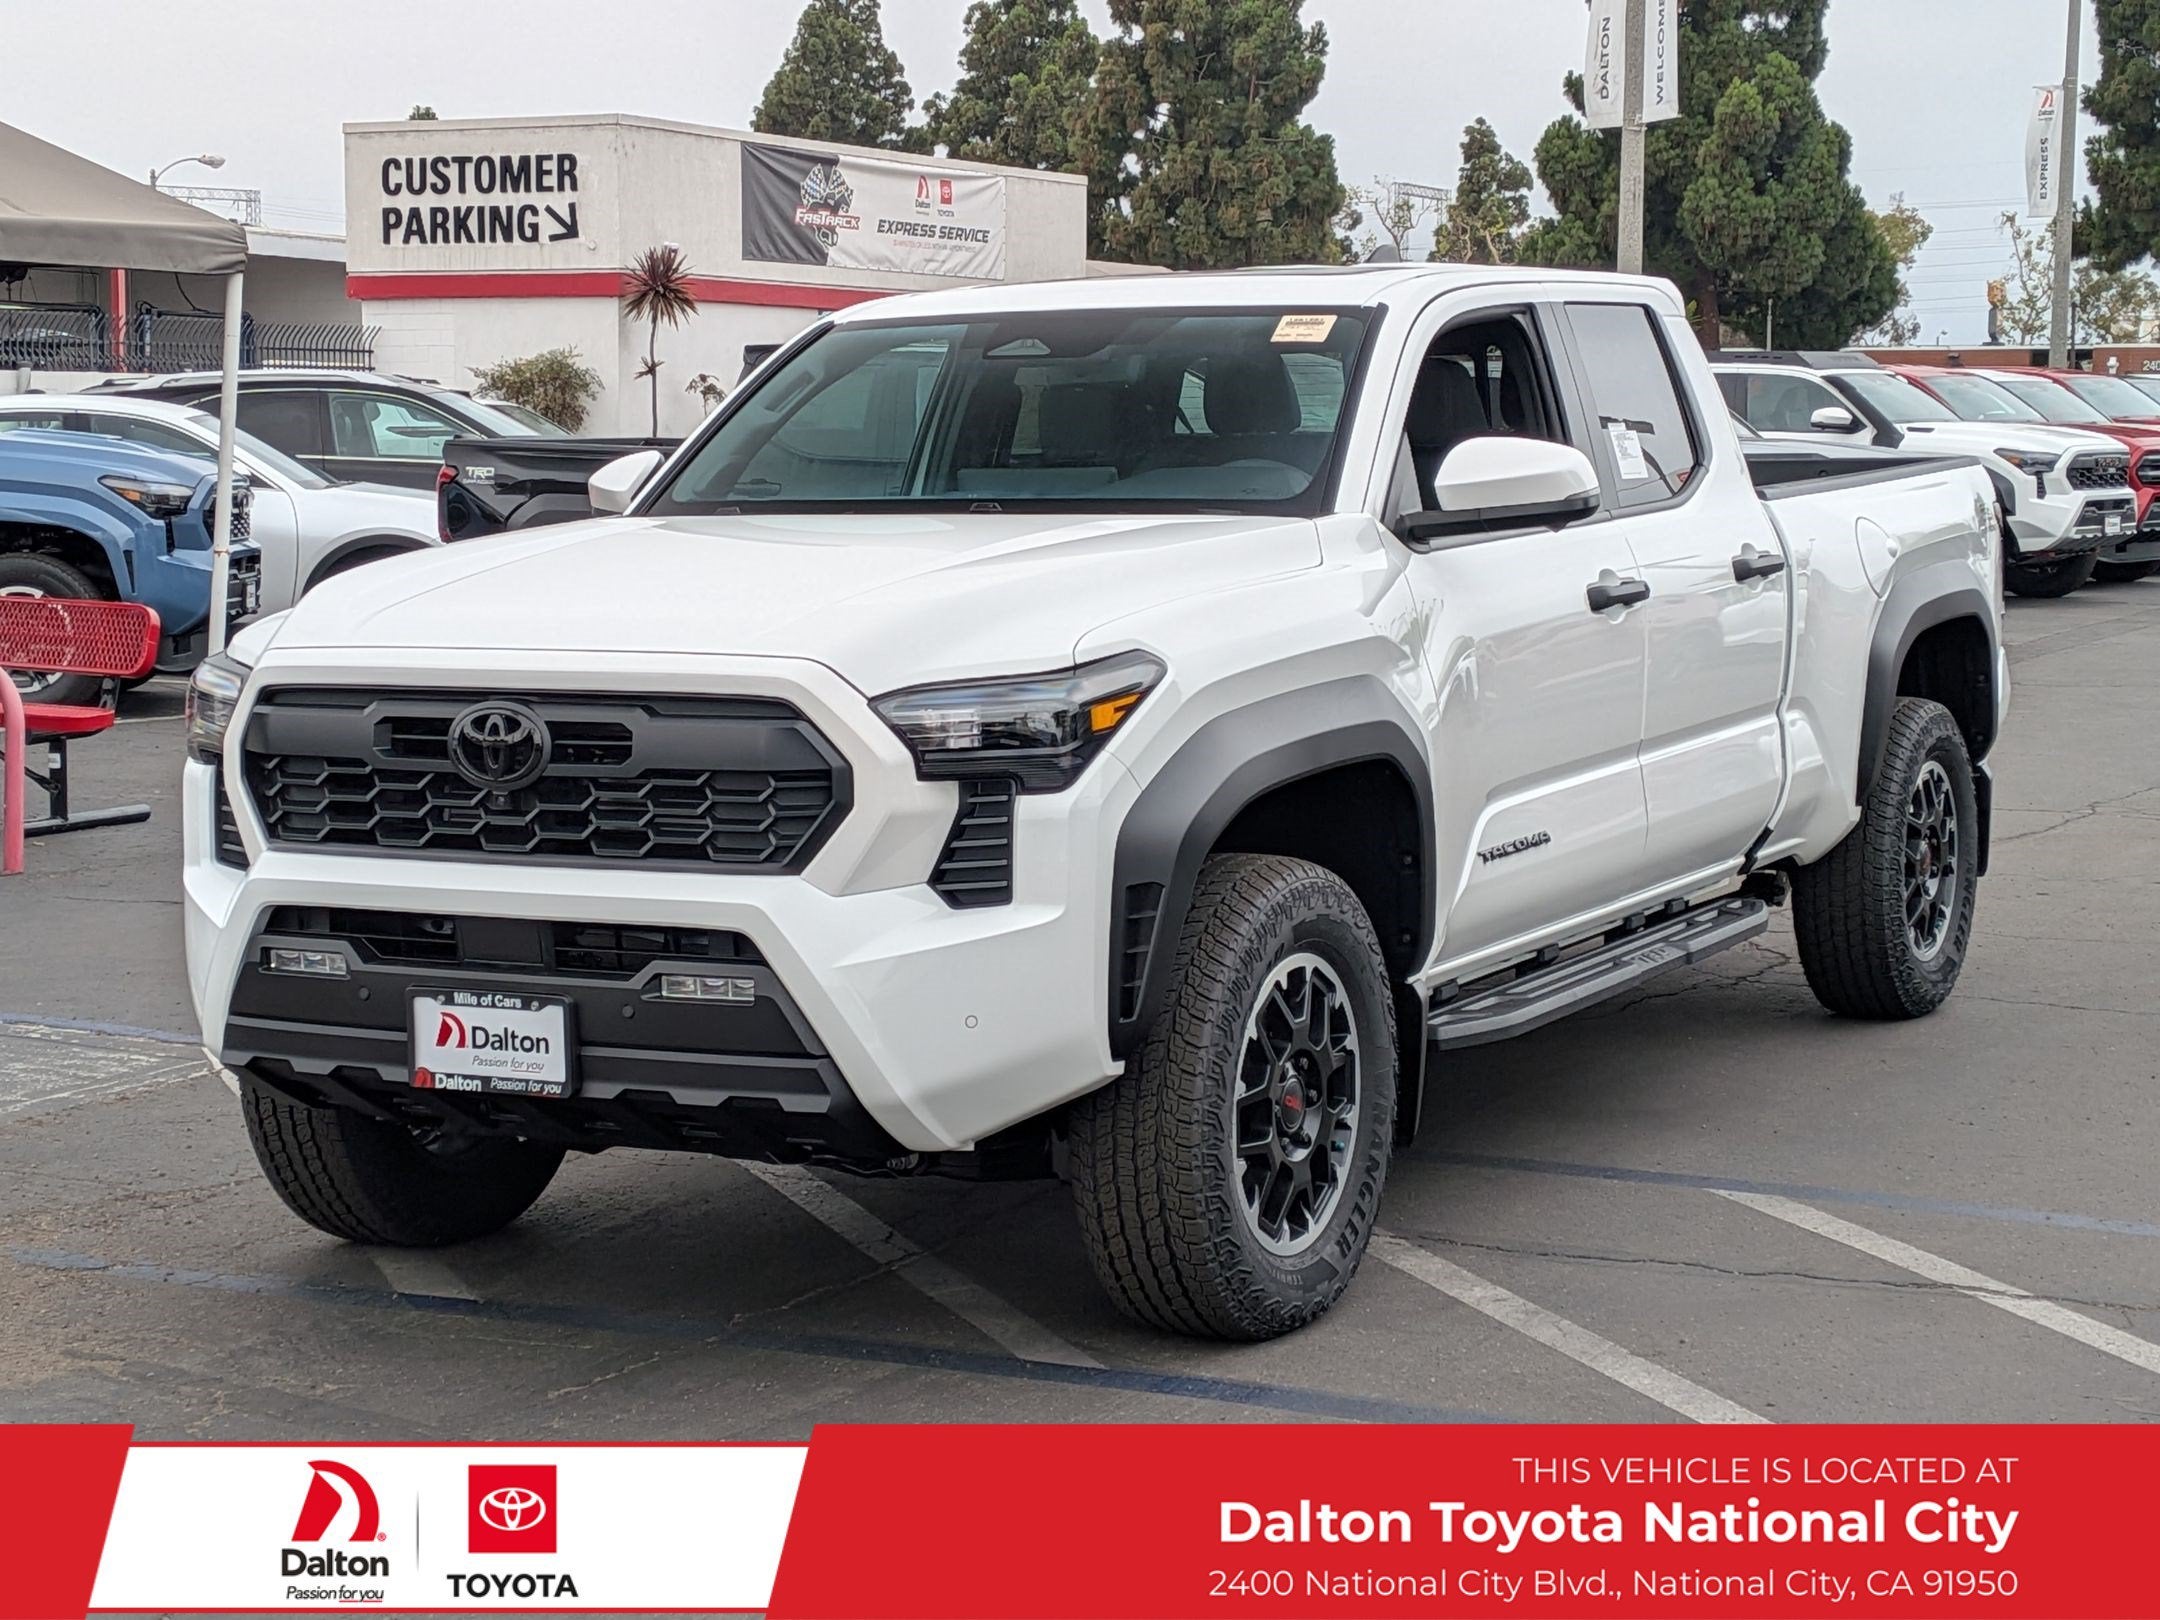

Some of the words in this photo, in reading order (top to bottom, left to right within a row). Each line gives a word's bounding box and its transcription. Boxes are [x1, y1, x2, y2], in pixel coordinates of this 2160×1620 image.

[1600, 16, 1611, 100] DALTON
[382, 153, 578, 196] CUSTOMER
[2040, 137, 2049, 200] EXPRESS
[382, 204, 540, 245] PARKING
[876, 219, 937, 239] EXPRESS
[938, 225, 991, 244] SERVICE
[465, 466, 495, 479] TRD
[1477, 830, 1551, 865] TACOMA
[453, 991, 477, 1005] Mile
[480, 993, 492, 1007] of
[494, 995, 522, 1009] Cars
[471, 1026, 550, 1054] Dalton
[472, 1055, 508, 1068] Passion
[509, 1059, 525, 1071] for
[525, 1061, 545, 1072] you
[434, 1074, 482, 1092] Dalton
[490, 1078, 526, 1092] Passion
[527, 1080, 542, 1095] for
[542, 1083, 562, 1095] you
